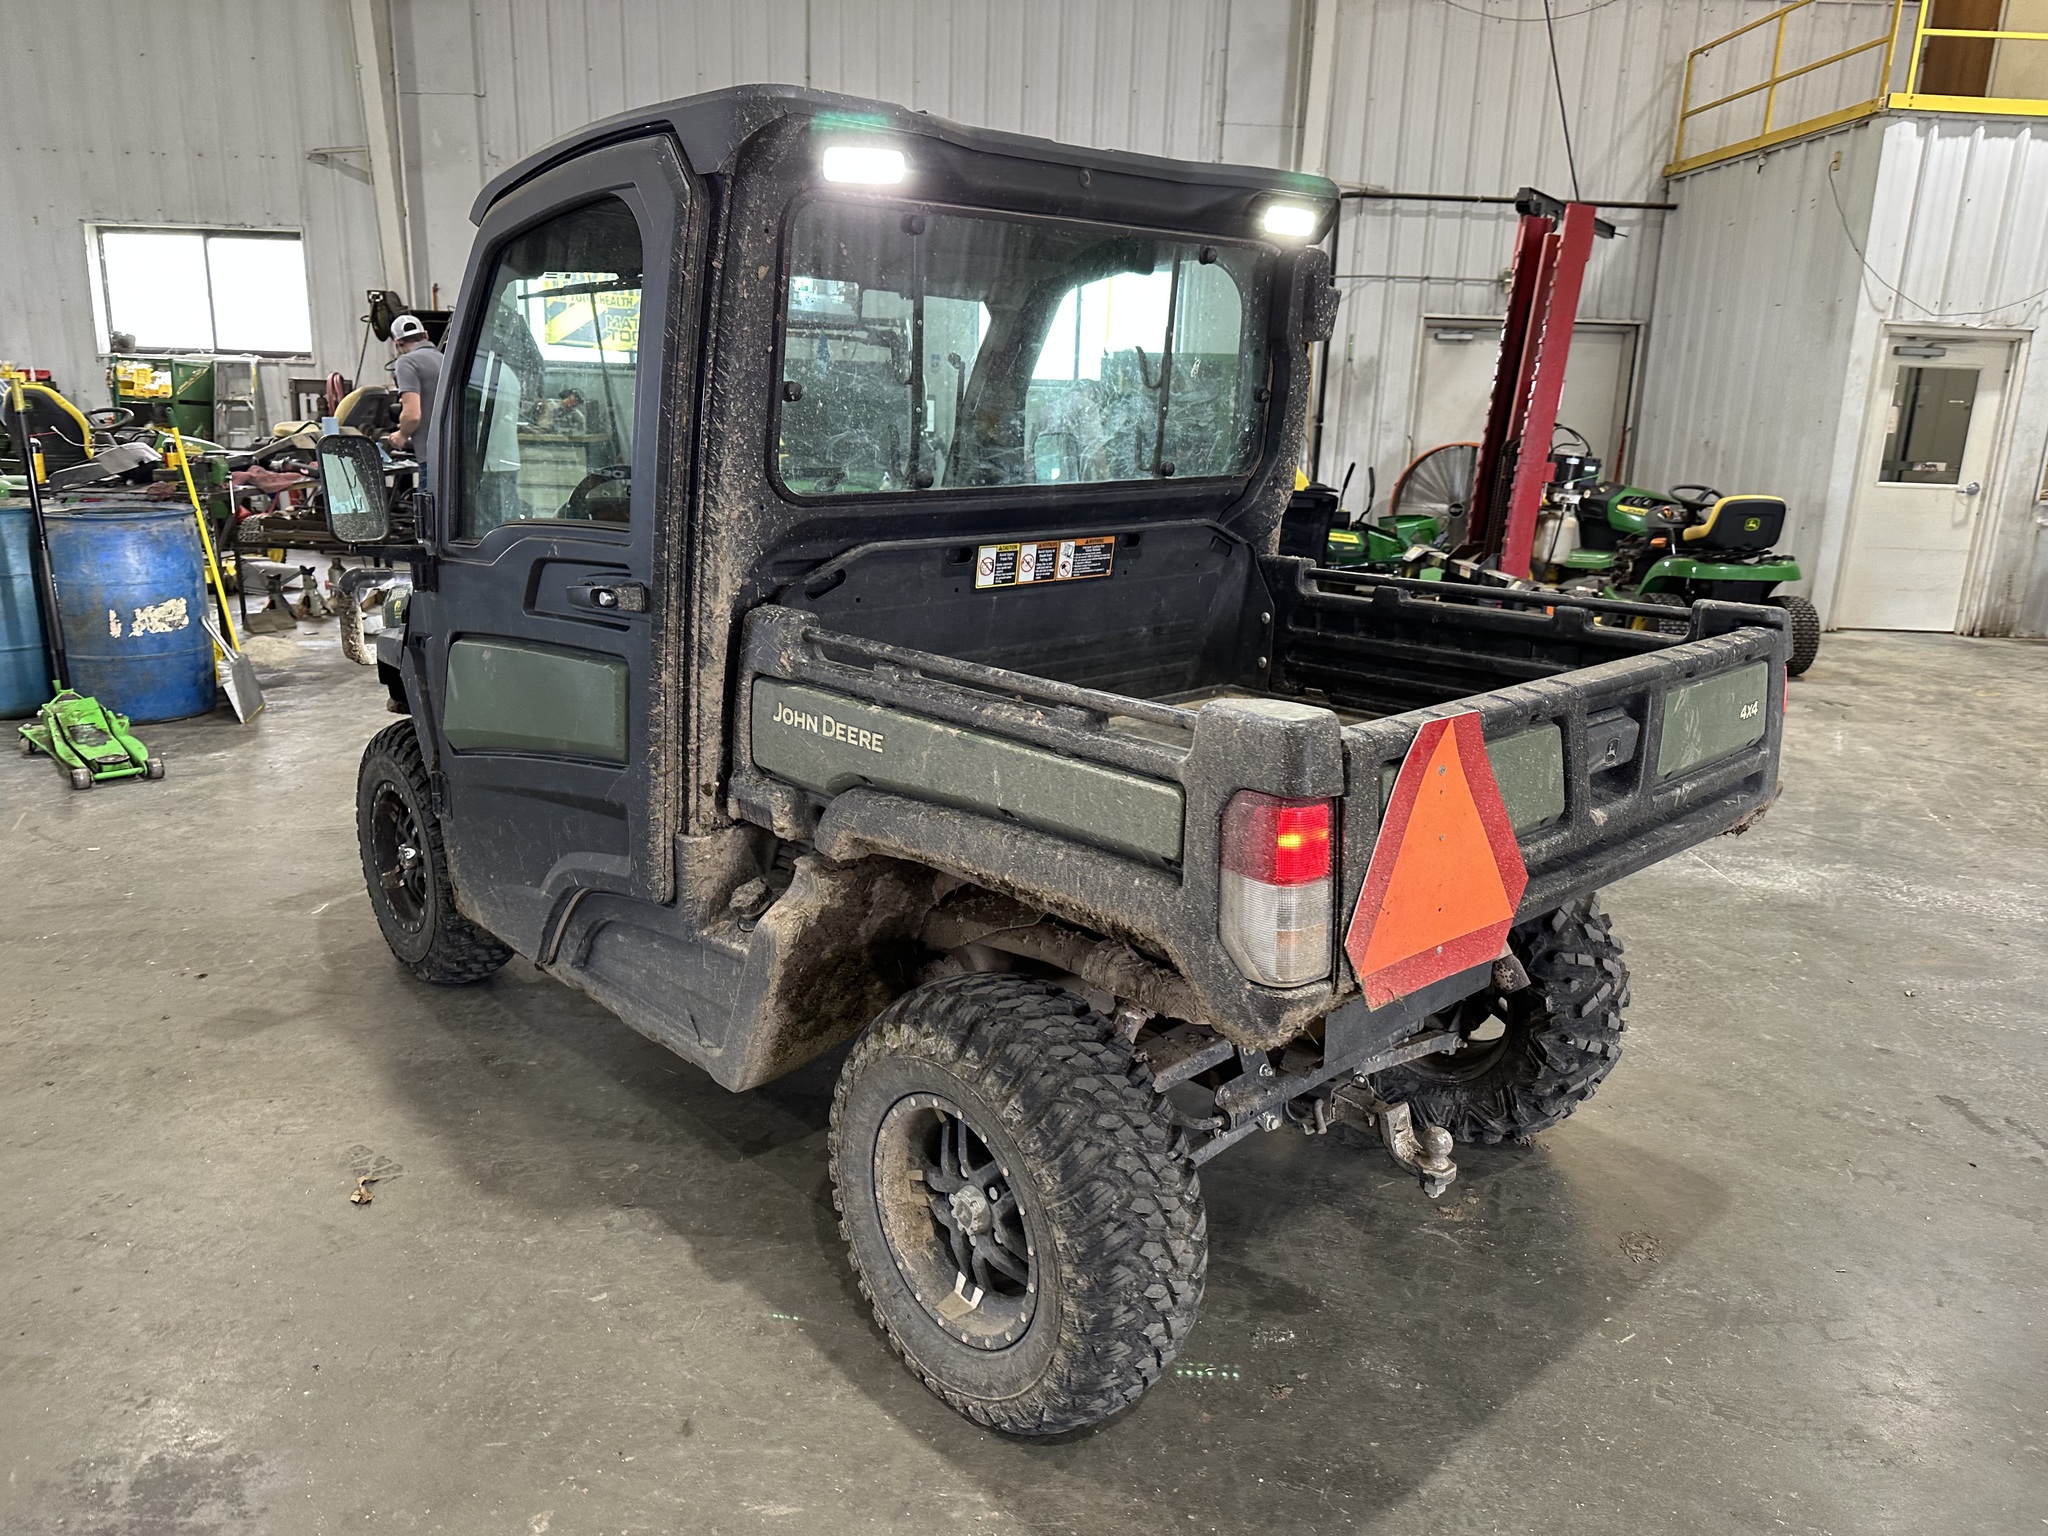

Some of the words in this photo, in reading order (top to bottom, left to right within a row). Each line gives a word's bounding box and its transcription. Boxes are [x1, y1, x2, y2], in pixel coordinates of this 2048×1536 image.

[600, 295, 633, 307] HEALTH
[773, 702, 818, 734] JOHN
[822, 714, 884, 753] DEERE
